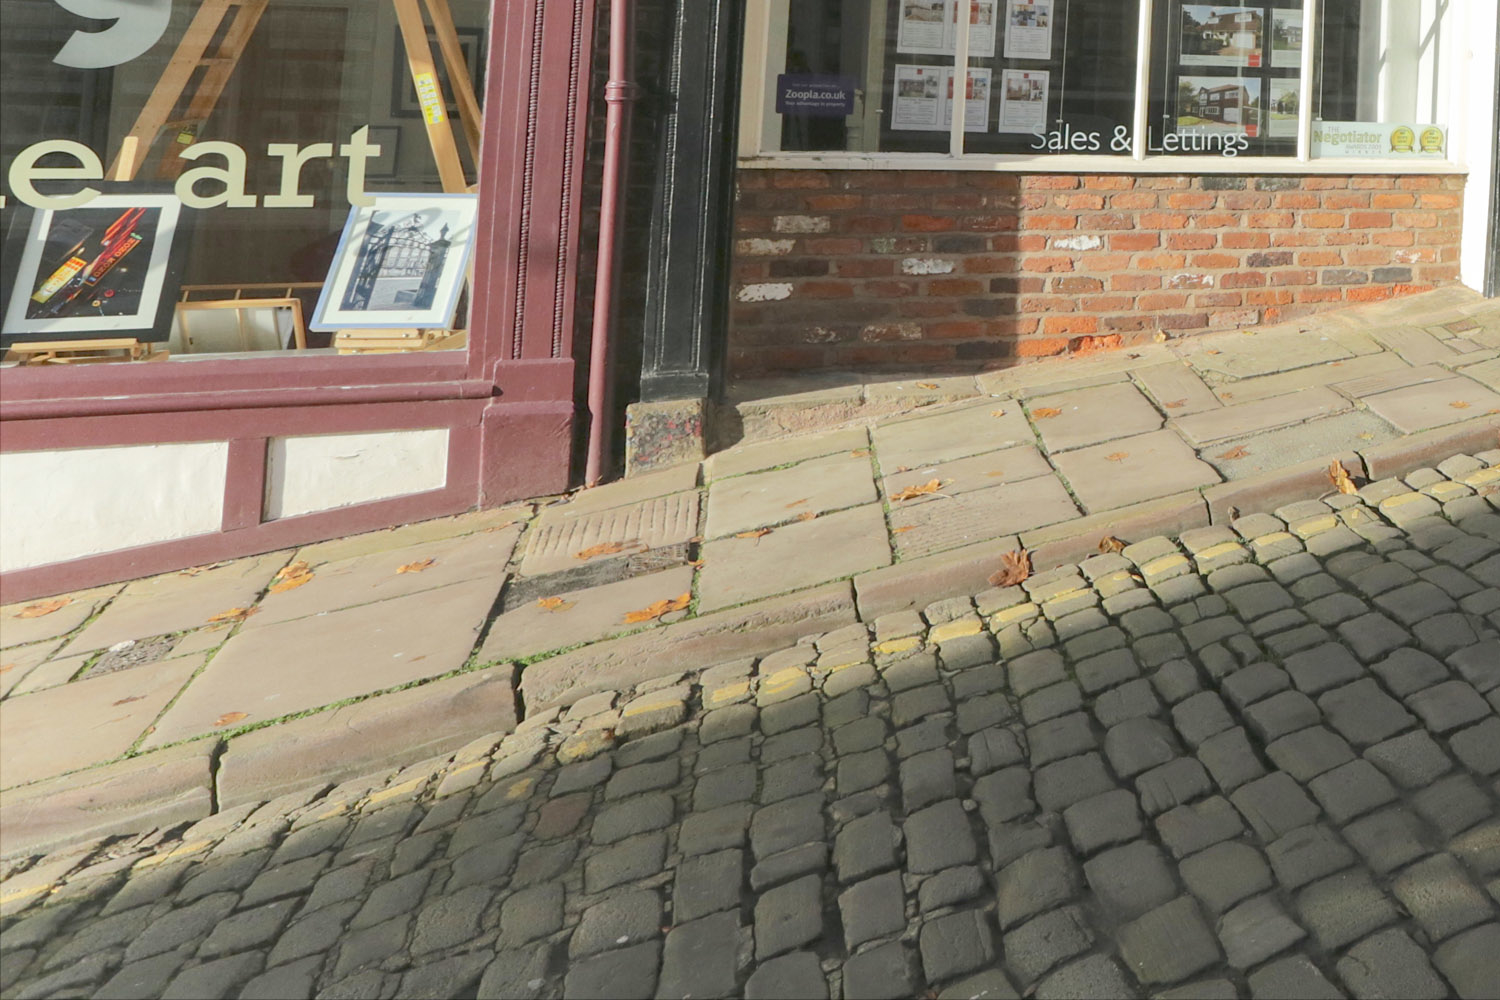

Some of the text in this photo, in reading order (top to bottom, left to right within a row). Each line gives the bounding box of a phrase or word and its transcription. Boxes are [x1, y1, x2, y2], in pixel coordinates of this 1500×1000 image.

[784, 89, 846, 101] Zoopla.co.uk
[1031, 123, 1249, 157] Sales & Lettings
[1312, 131, 1382, 145] Negotiator
[174, 124, 382, 209] art
